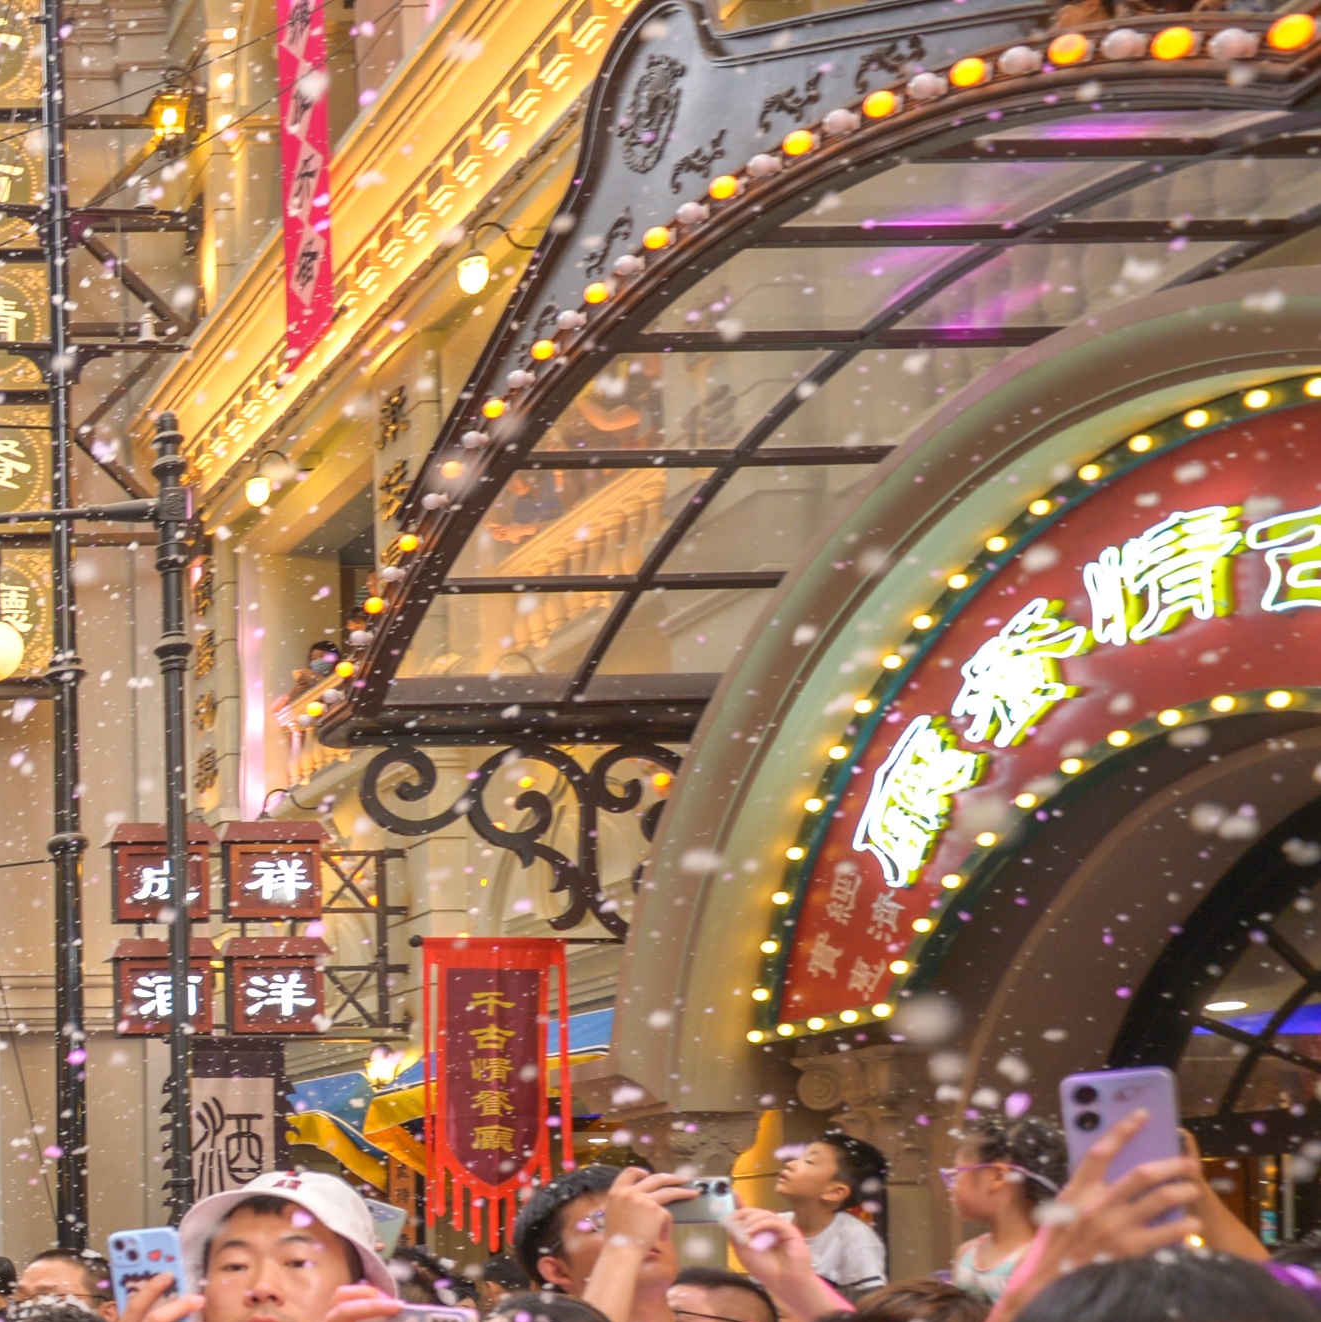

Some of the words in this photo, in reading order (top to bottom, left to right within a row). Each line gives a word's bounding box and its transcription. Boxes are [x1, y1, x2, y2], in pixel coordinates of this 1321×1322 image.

[469, 990, 517, 1153] 千古情餐廳
